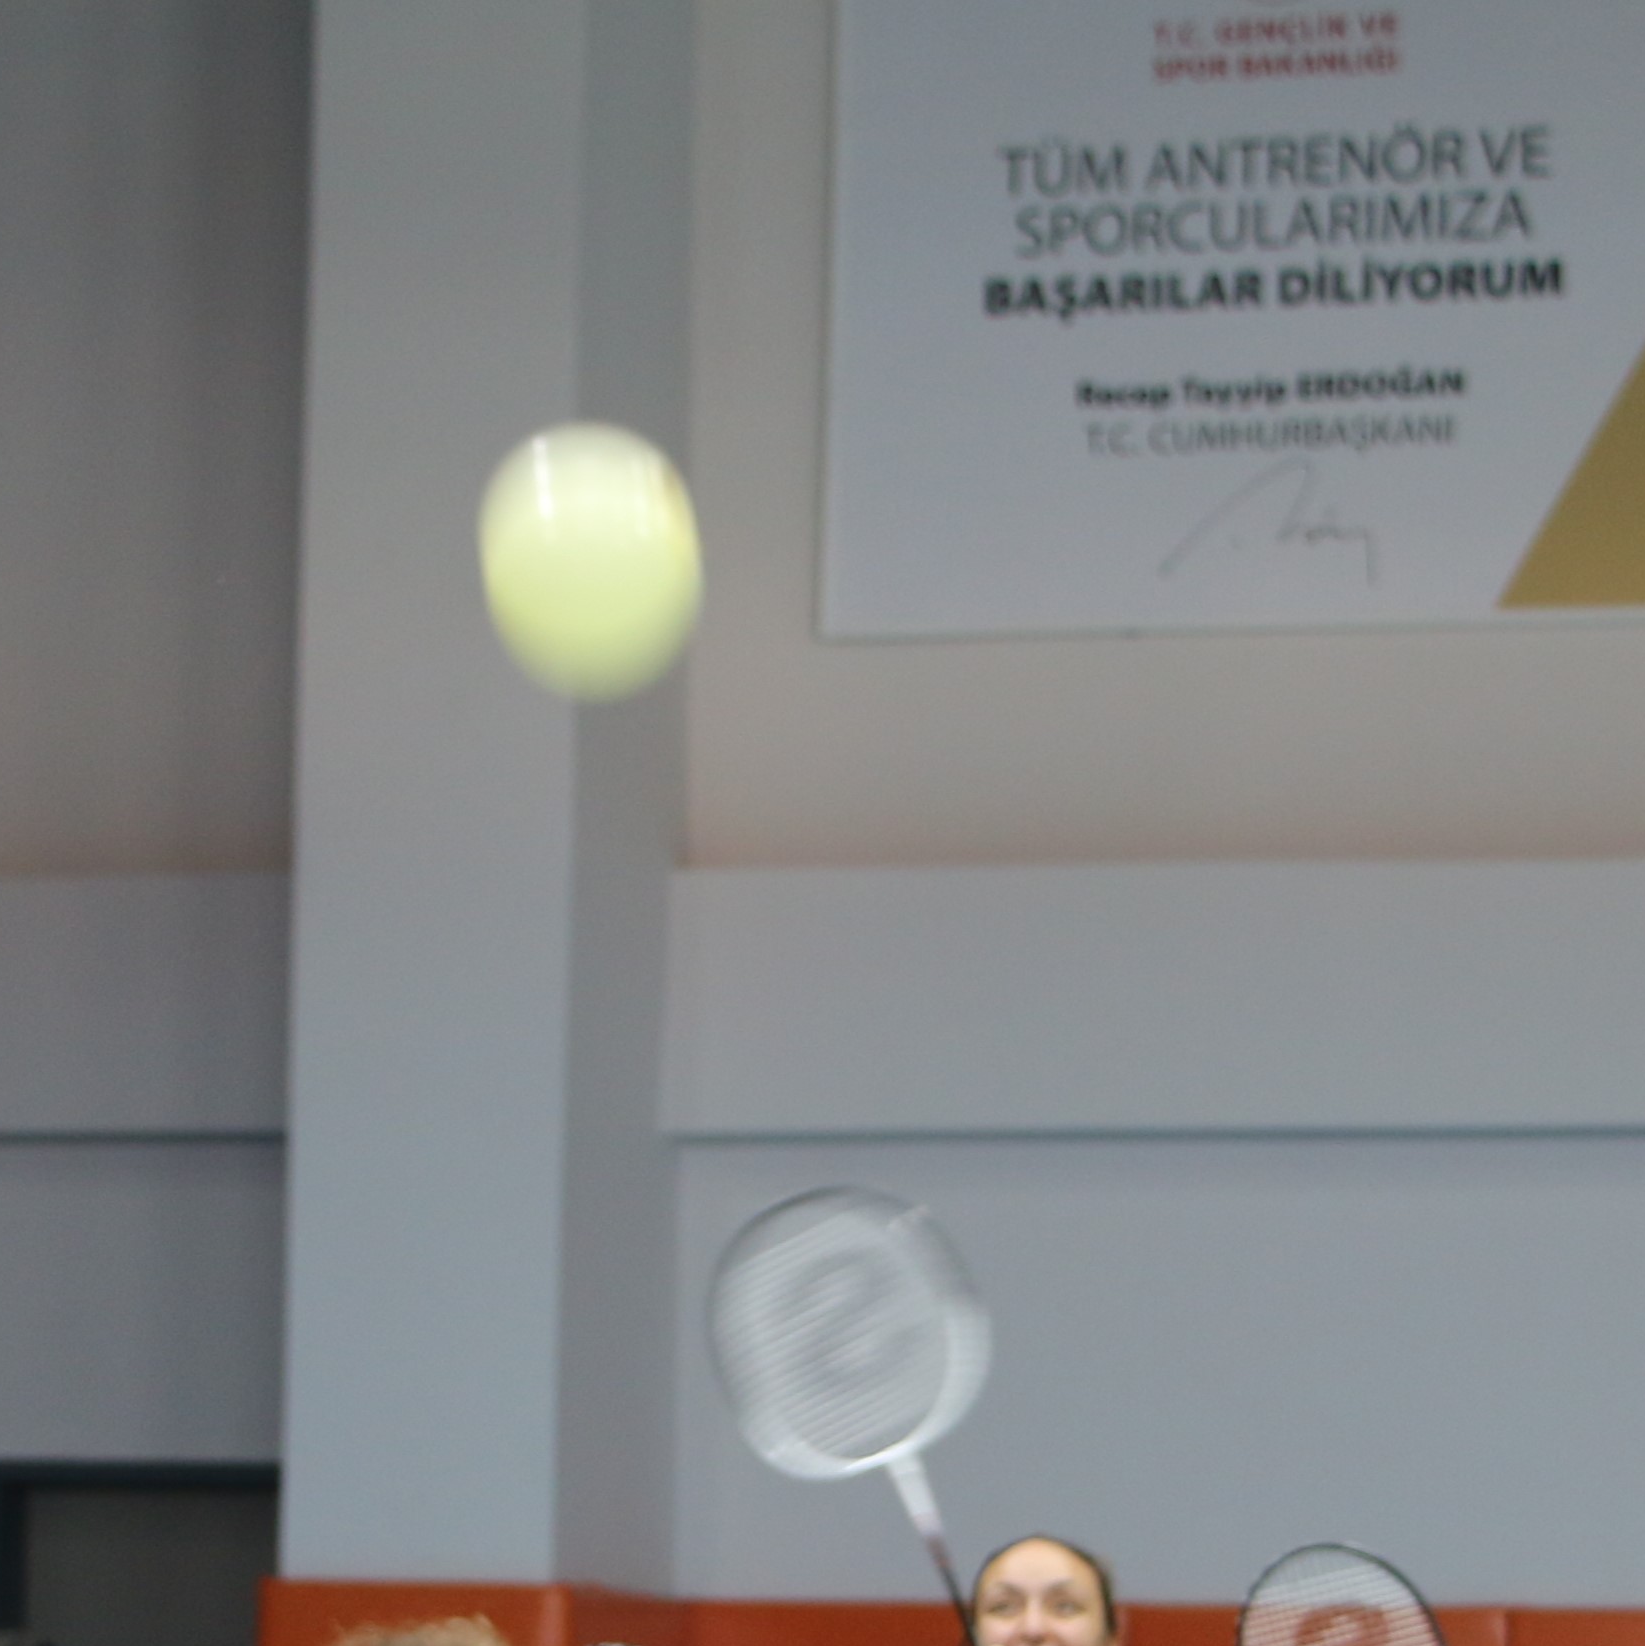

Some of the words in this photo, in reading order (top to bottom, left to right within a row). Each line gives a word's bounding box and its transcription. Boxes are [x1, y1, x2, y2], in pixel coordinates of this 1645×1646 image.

[1359, 10, 1397, 37] VE
[1000, 133, 1127, 197] TÜM
[1146, 123, 1463, 190] ANTRENÖR
[1480, 124, 1550, 180] VE
[1014, 188, 1532, 259] SPORCULARIMIZA
[983, 267, 1264, 323] BAŞARILAR
[1277, 257, 1563, 305] DİLİYORUM
[1180, 373, 1287, 408] Tayyip
[1297, 362, 1465, 400] ERDOĞAN
[1148, 412, 1457, 456] CUMHURBAŞKANI
